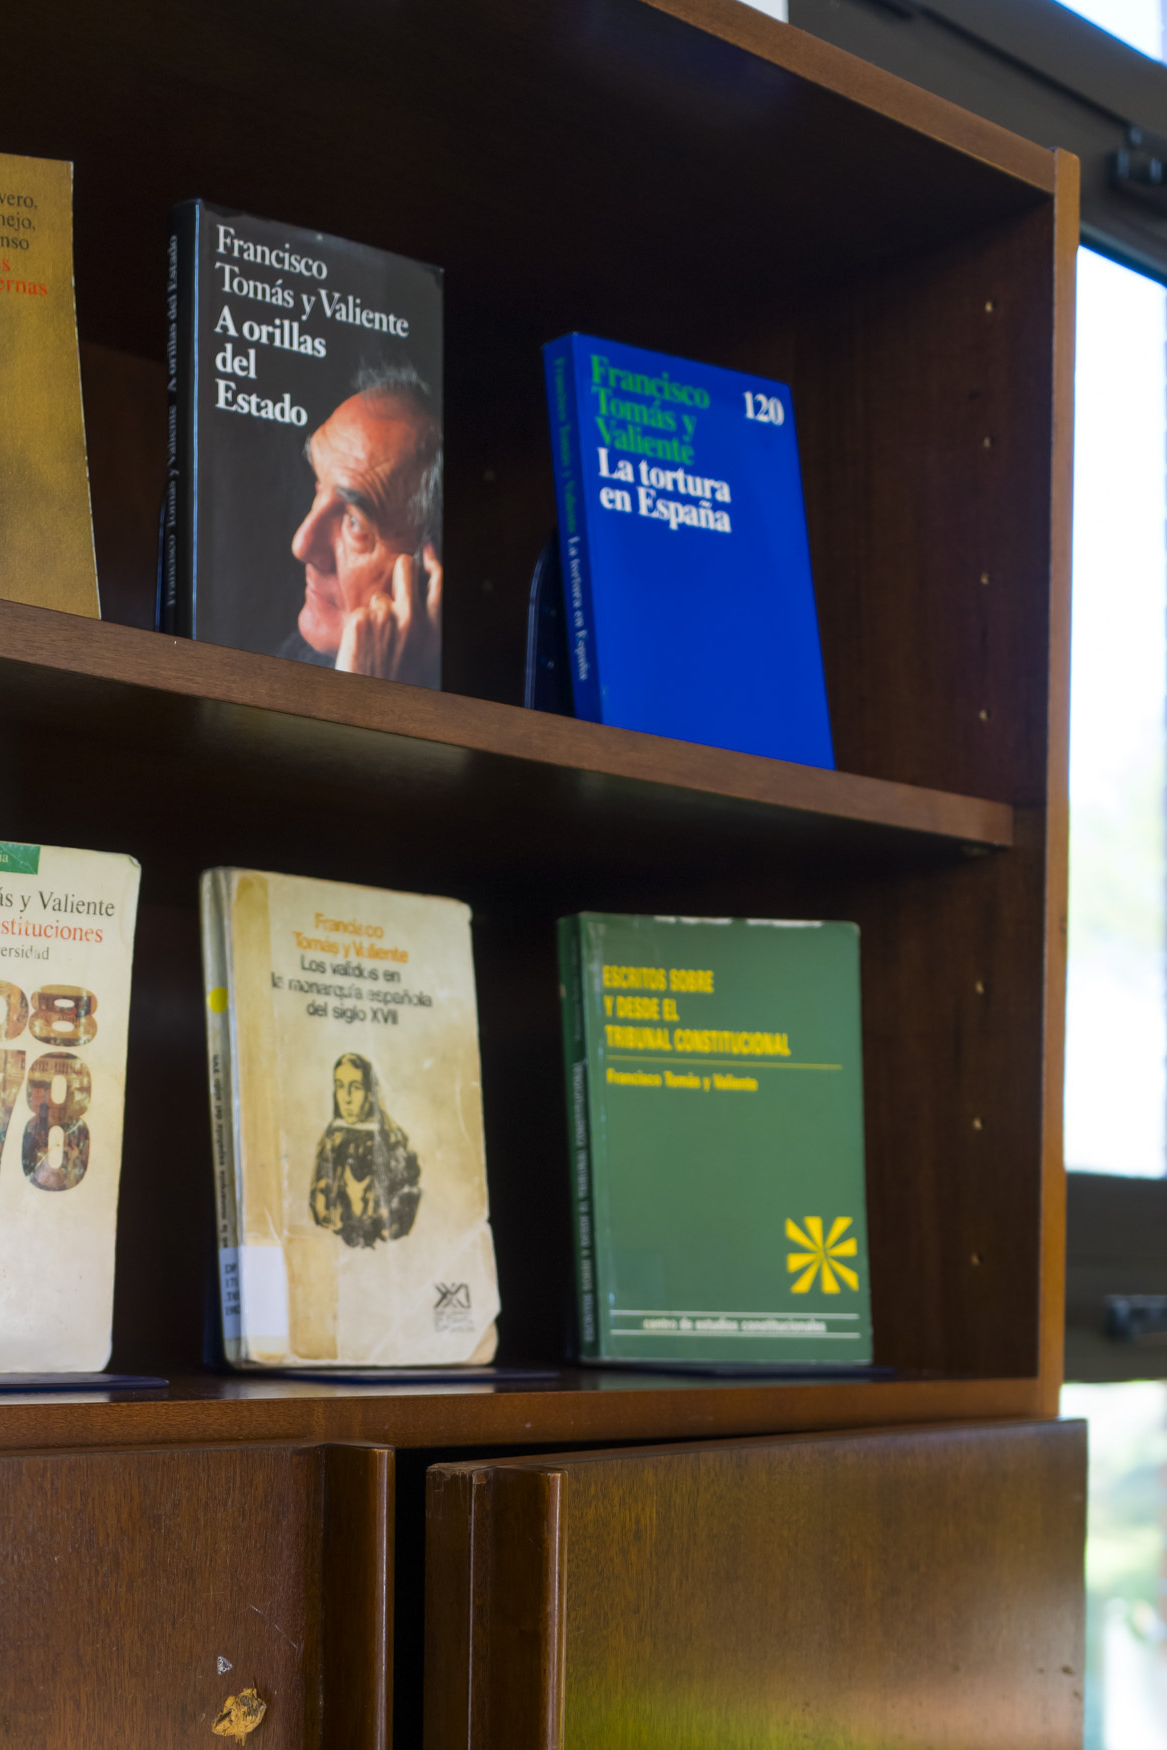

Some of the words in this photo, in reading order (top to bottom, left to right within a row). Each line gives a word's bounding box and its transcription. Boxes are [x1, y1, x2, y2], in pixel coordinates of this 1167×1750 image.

[215, 224, 328, 280] Francisco
[215, 261, 295, 307] Tomás
[300, 293, 317, 321] y
[317, 289, 410, 338] Valiente
[214, 304, 238, 336] A
[242, 318, 327, 358] orillas
[215, 343, 257, 379] del
[215, 379, 308, 427] Estado
[590, 355, 710, 410] Francisco
[590, 385, 676, 433] Tomás
[683, 413, 697, 443] y
[742, 391, 785, 426] 120
[595, 416, 695, 466] Valiente
[598, 447, 634, 484] La
[639, 459, 732, 503] tortura
[600, 485, 632, 514] en
[638, 486, 732, 534] España
[20, 891, 31, 913] y
[37, 889, 115, 919] Valiente
[300, 954, 326, 974] Los
[382, 969, 401, 983] en
[342, 939, 352, 960] y
[602, 965, 667, 991] ESCRITOS
[670, 969, 715, 994] SOBRE
[306, 1000, 329, 1018] del
[332, 1002, 367, 1025] siglo
[370, 1005, 399, 1026] XVII
[604, 995, 615, 1018] Y
[617, 996, 660, 1020] DESDE
[663, 999, 680, 1022] EL
[605, 1024, 672, 1051] TRIBUNAL
[674, 1028, 791, 1056] CONSTITUCIONAL
